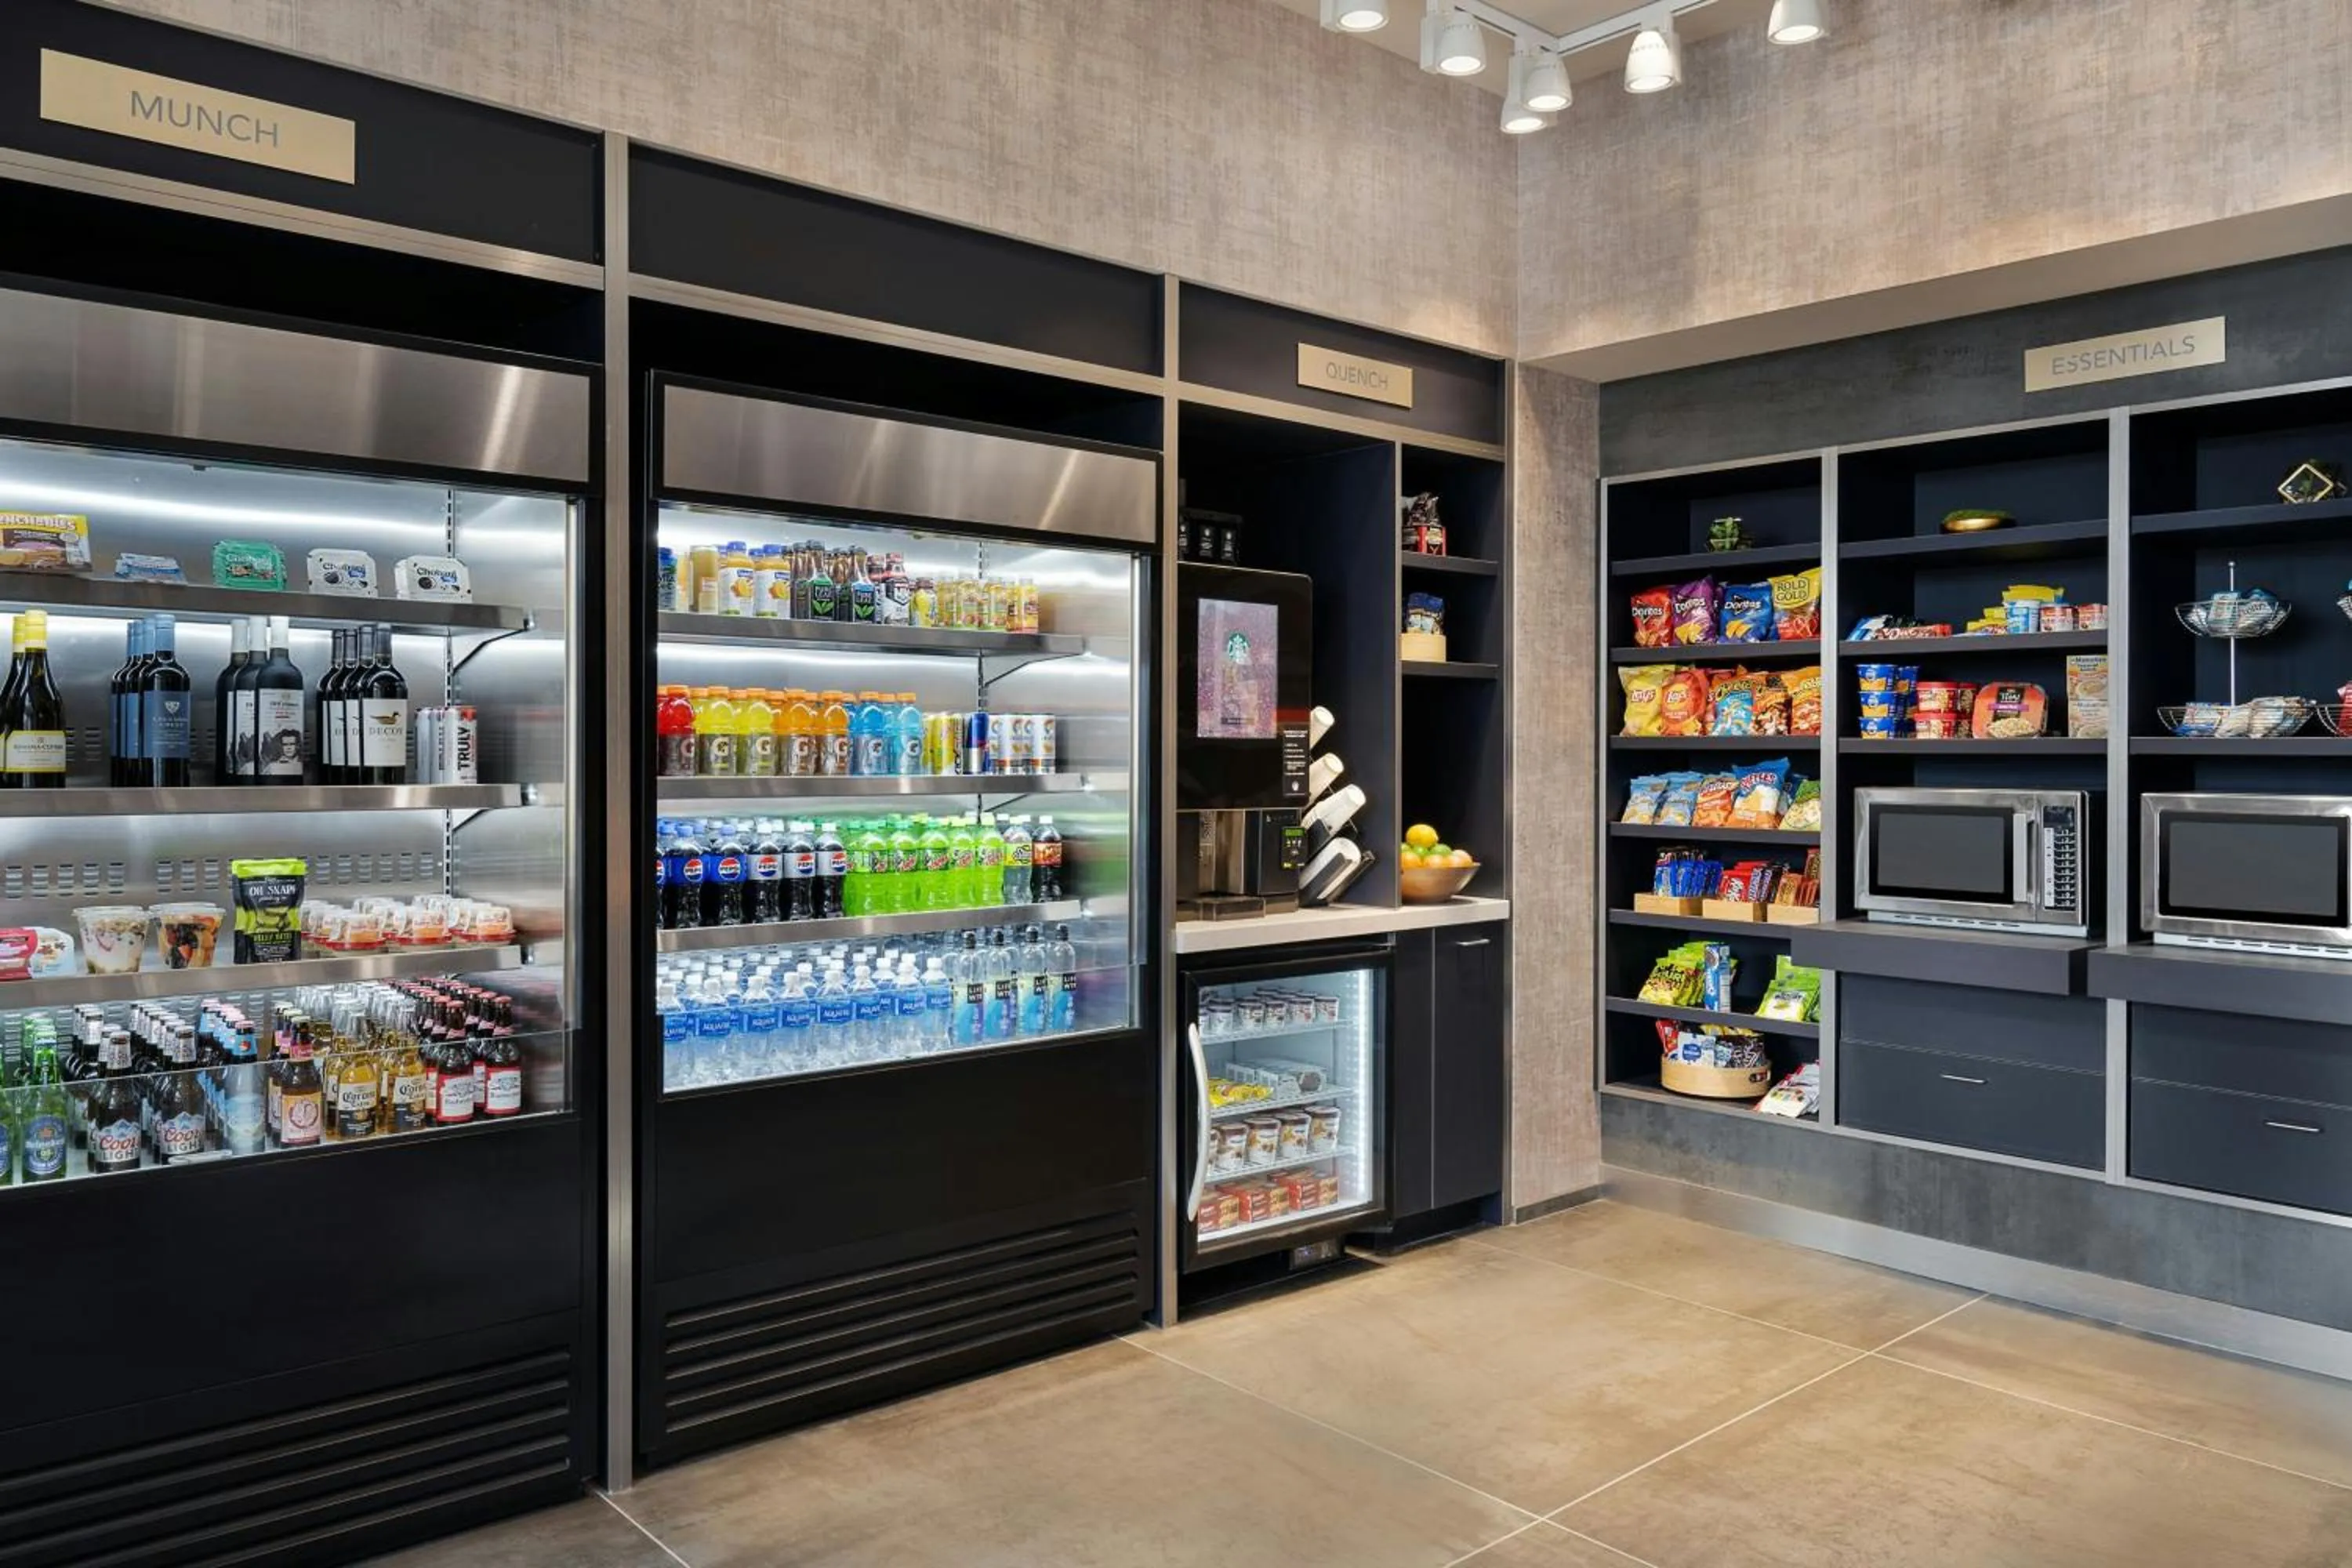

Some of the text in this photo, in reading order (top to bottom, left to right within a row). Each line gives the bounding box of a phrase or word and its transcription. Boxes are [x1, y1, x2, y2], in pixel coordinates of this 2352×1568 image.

[131, 90, 280, 149] MUNCH
[2050, 342, 2197, 376] ESSENTIALS
[1325, 361, 1390, 391] QUENCH
[1777, 579, 1807, 592] ROLD
[1776, 590, 1808, 602] GOLD
[1632, 606, 1663, 617] Doritos
[1675, 597, 1706, 614] Doritos
[1724, 601, 1762, 611] Doritos
[368, 727, 404, 736] DECOY
[458, 726, 471, 771] TRULY
[711, 737, 730, 757] G
[756, 737, 771, 755] G
[249, 886, 263, 896] OH
[100, 1134, 139, 1150] Coor
[164, 1127, 202, 1143] Coor
